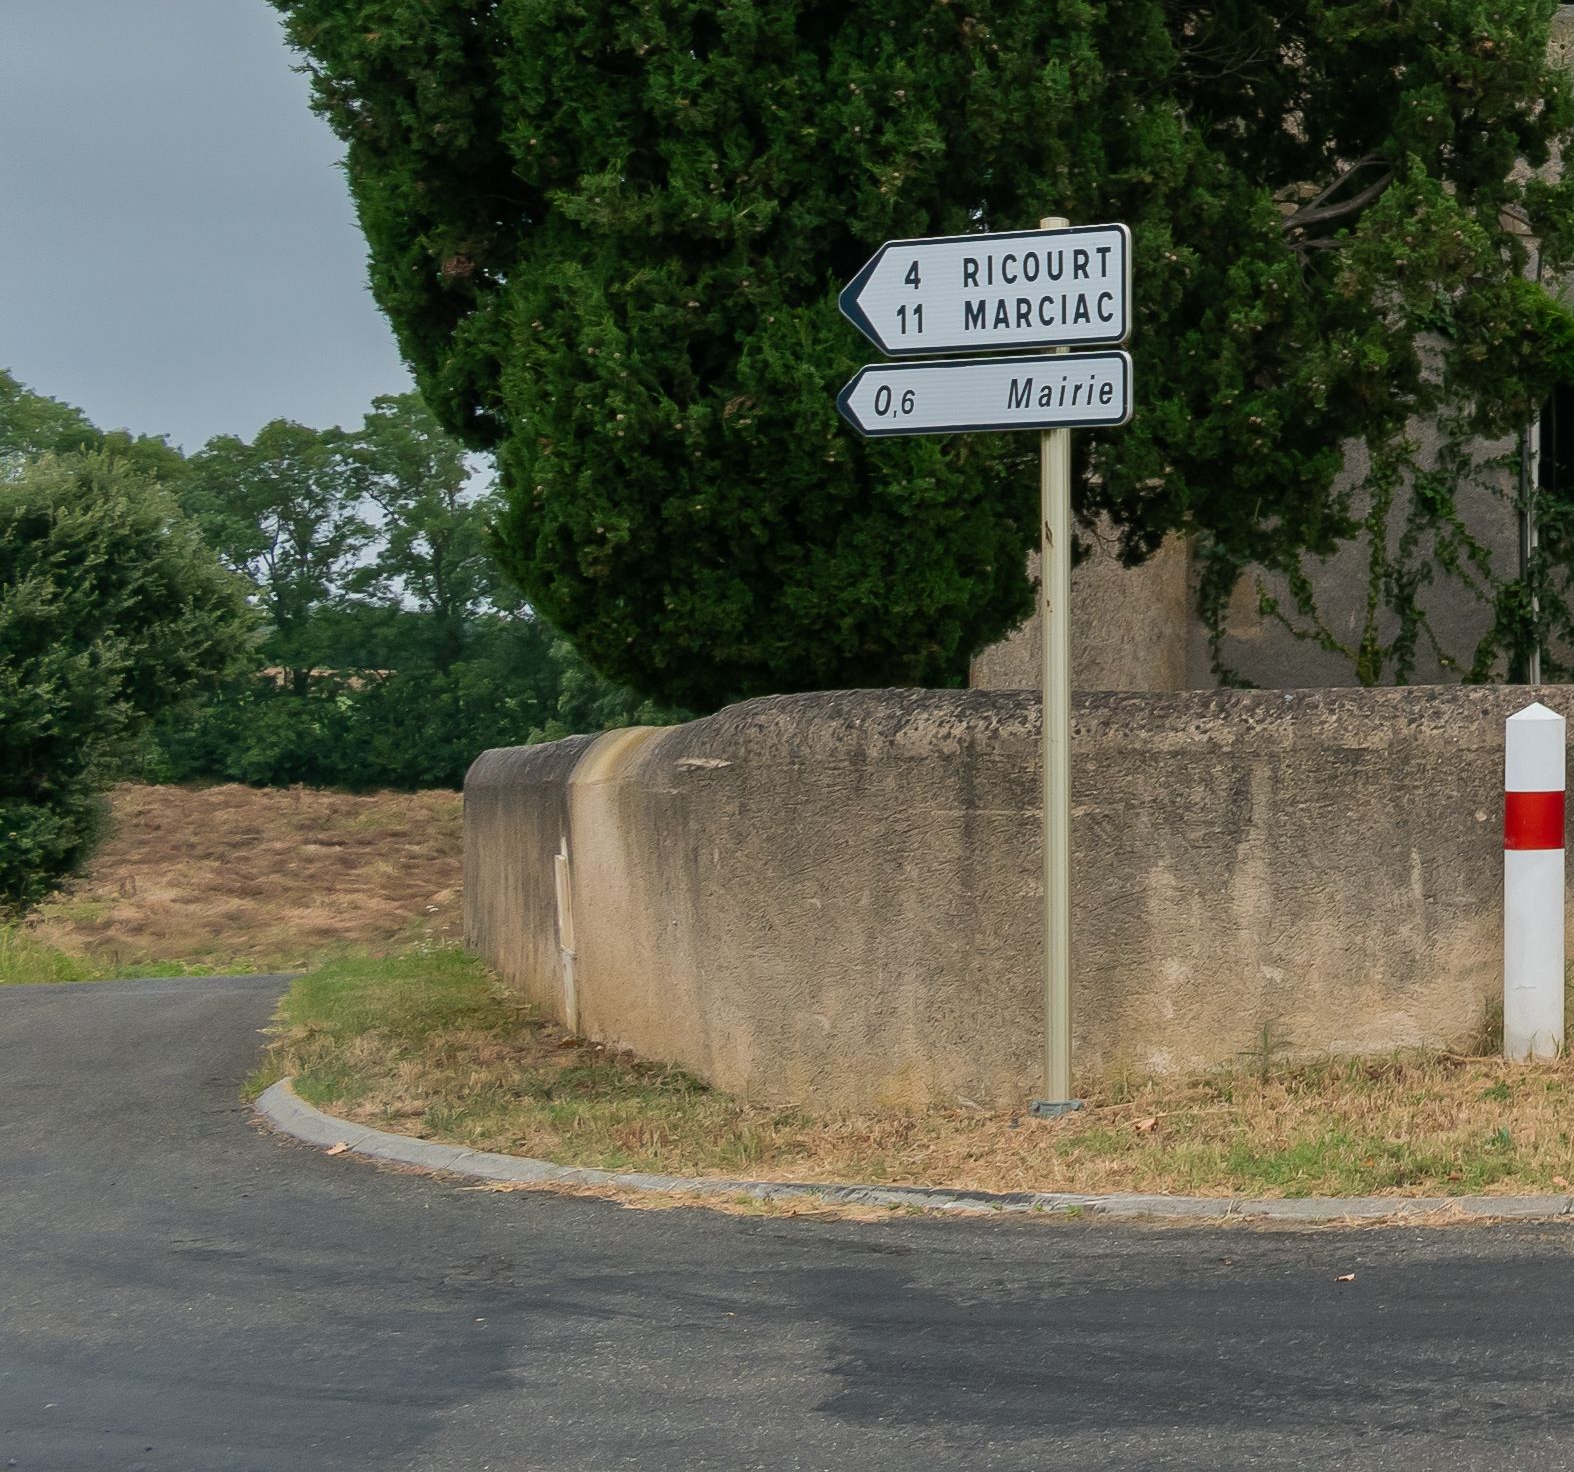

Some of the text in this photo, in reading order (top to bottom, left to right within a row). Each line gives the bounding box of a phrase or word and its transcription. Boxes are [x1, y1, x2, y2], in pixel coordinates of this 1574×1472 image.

[903, 246, 1112, 290] 4 RICOURT
[896, 291, 1115, 335] 11 MARCIAC
[873, 374, 1114, 418] 0,6 Mairie
